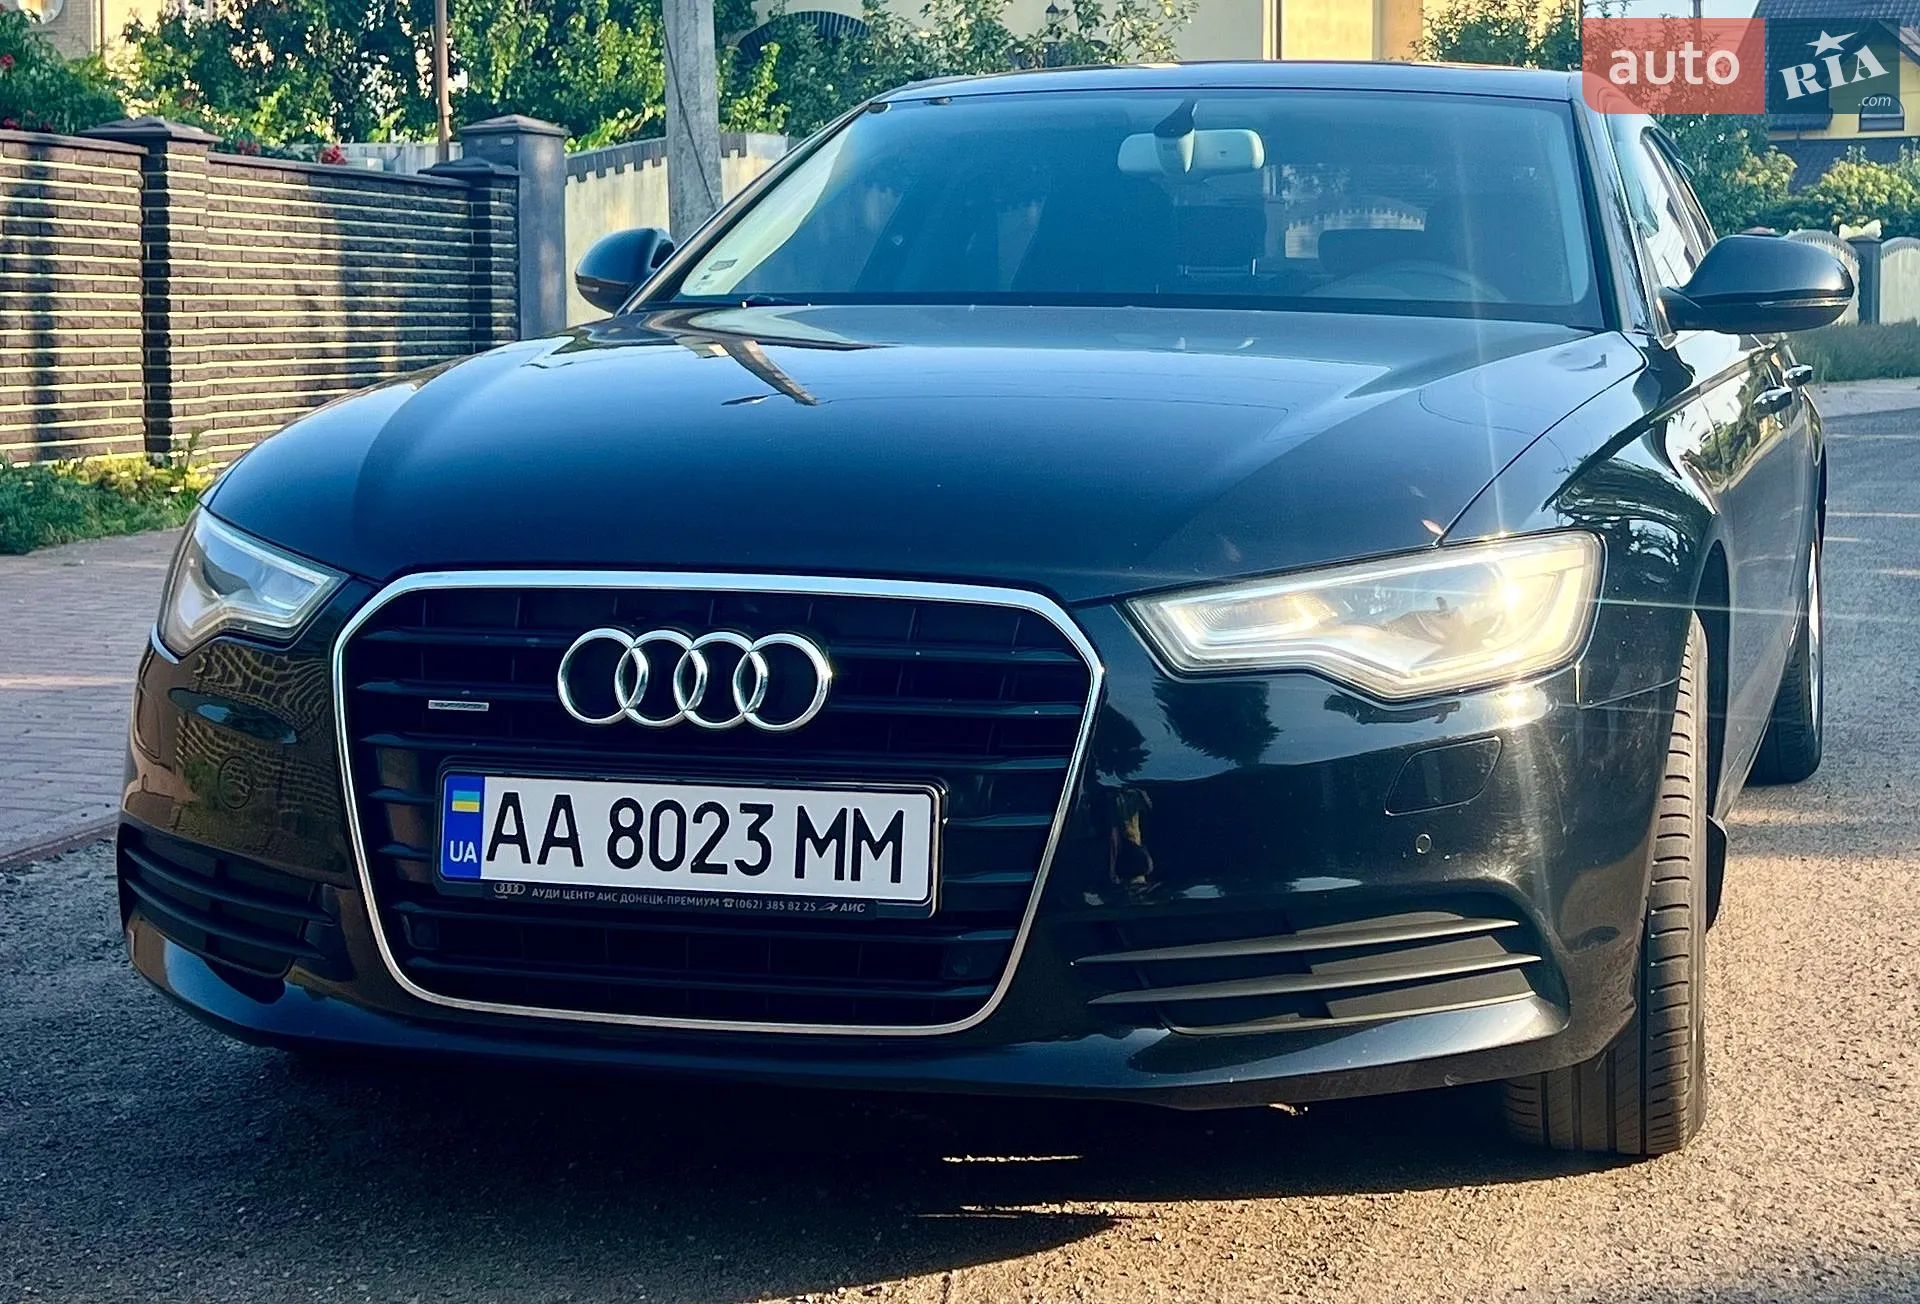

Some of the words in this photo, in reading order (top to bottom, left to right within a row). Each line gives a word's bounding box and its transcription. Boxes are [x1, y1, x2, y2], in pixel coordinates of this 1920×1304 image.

[486, 791, 584, 868] AA
[606, 797, 774, 877] 8023
[795, 804, 905, 884] MM
[449, 840, 478, 864] UA
[531, 888, 560, 899] АУДИ
[562, 890, 595, 901] ЦЕНТР
[597, 892, 618, 902] АИС
[619, 893, 720, 907] ДОНЕЦК-ПРЕМИУМ
[735, 899, 763, 910] (062)
